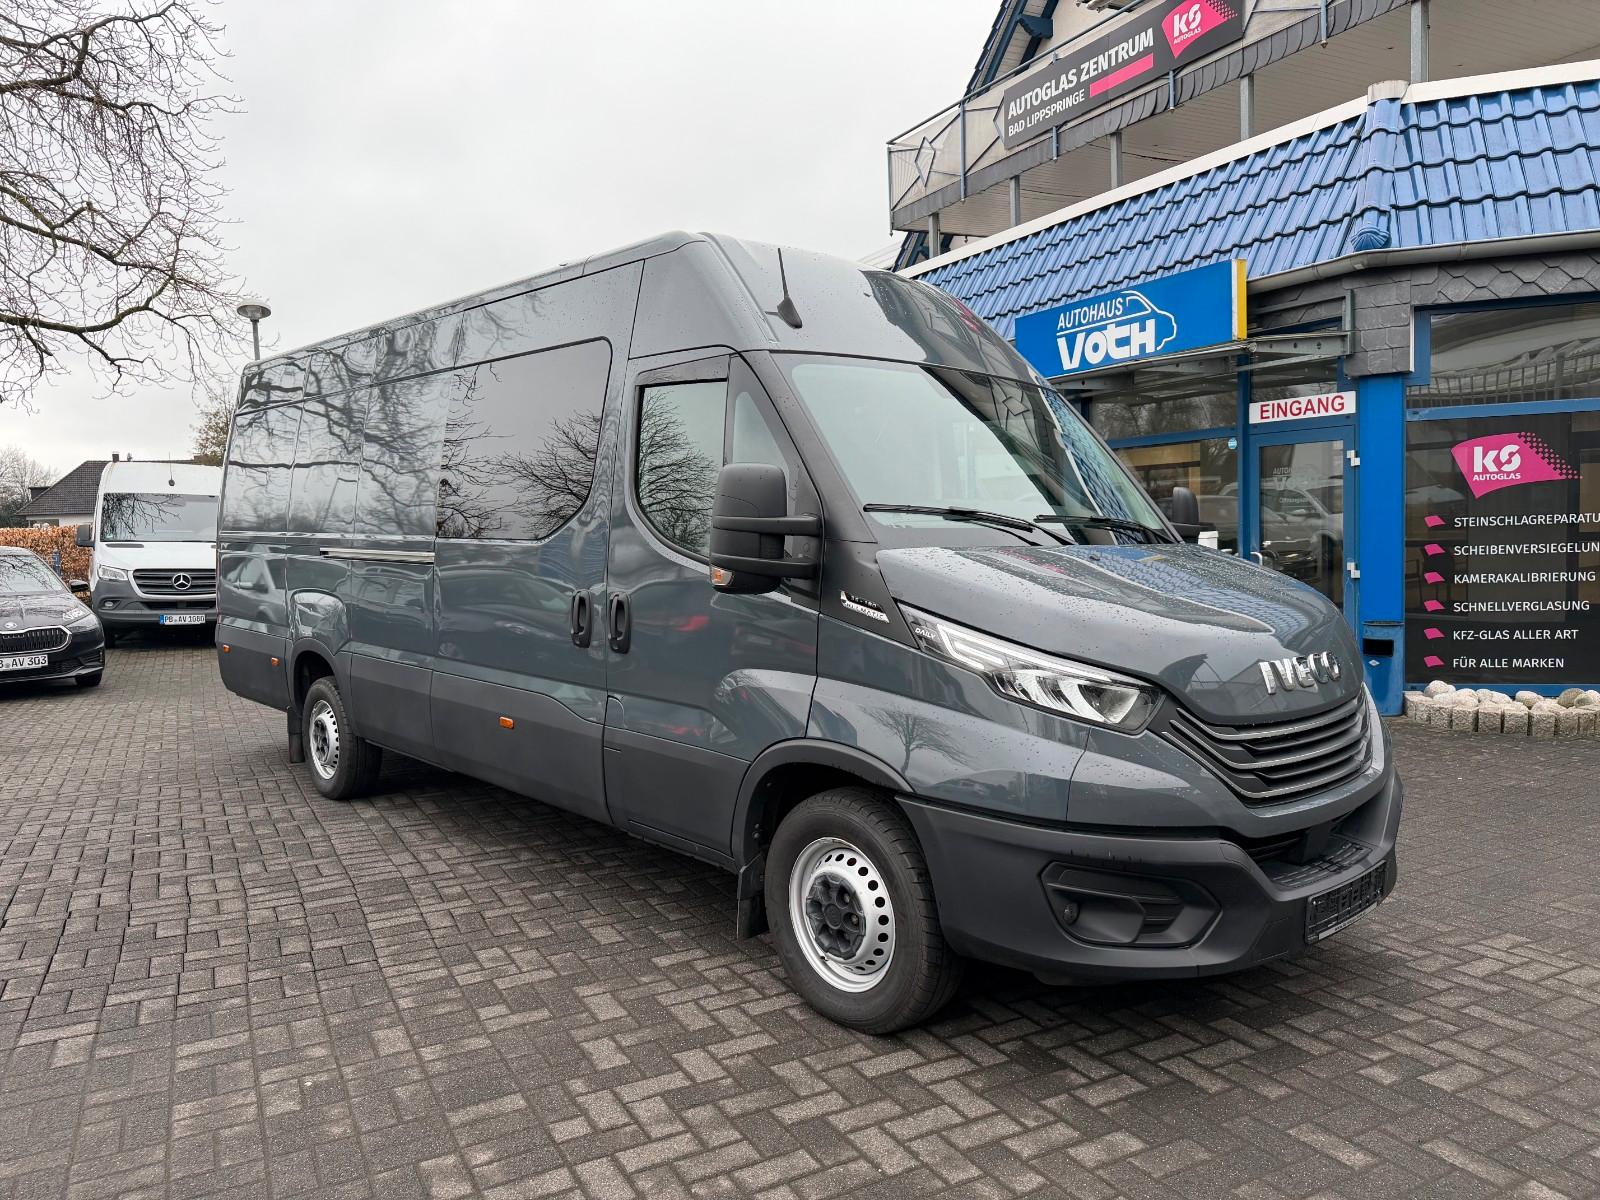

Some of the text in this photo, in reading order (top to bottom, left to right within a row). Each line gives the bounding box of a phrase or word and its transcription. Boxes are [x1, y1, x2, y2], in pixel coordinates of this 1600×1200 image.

[1173, 26, 1201, 45] AUTOGLAS
[1007, 27, 1154, 119] AUTOGLAS ZENTRUM
[1008, 88, 1085, 137] BAD LIPPSPRINGE
[1057, 297, 1123, 330] AUTOHAUS
[1259, 395, 1345, 420] EINGANG
[1472, 472, 1521, 481] AUTOGLAS
[1453, 512, 1600, 528] STEINSCHLAGREPARATU
[1453, 541, 1600, 556] SCHEIBENVERSIEGELUN
[1454, 571, 1596, 584] KAMERAKALIBRIERUNG
[1453, 600, 1590, 613] SCHNELLVERGLASUNG
[914, 627, 937, 640] DAILY
[1453, 629, 1579, 641] KFZ-GLAS ALLER ART
[11, 657, 25, 668] AV
[27, 655, 47, 666] 303
[1453, 656, 1564, 668] FÜR ALLE MARKEN
[1258, 650, 1341, 695] IVECO
